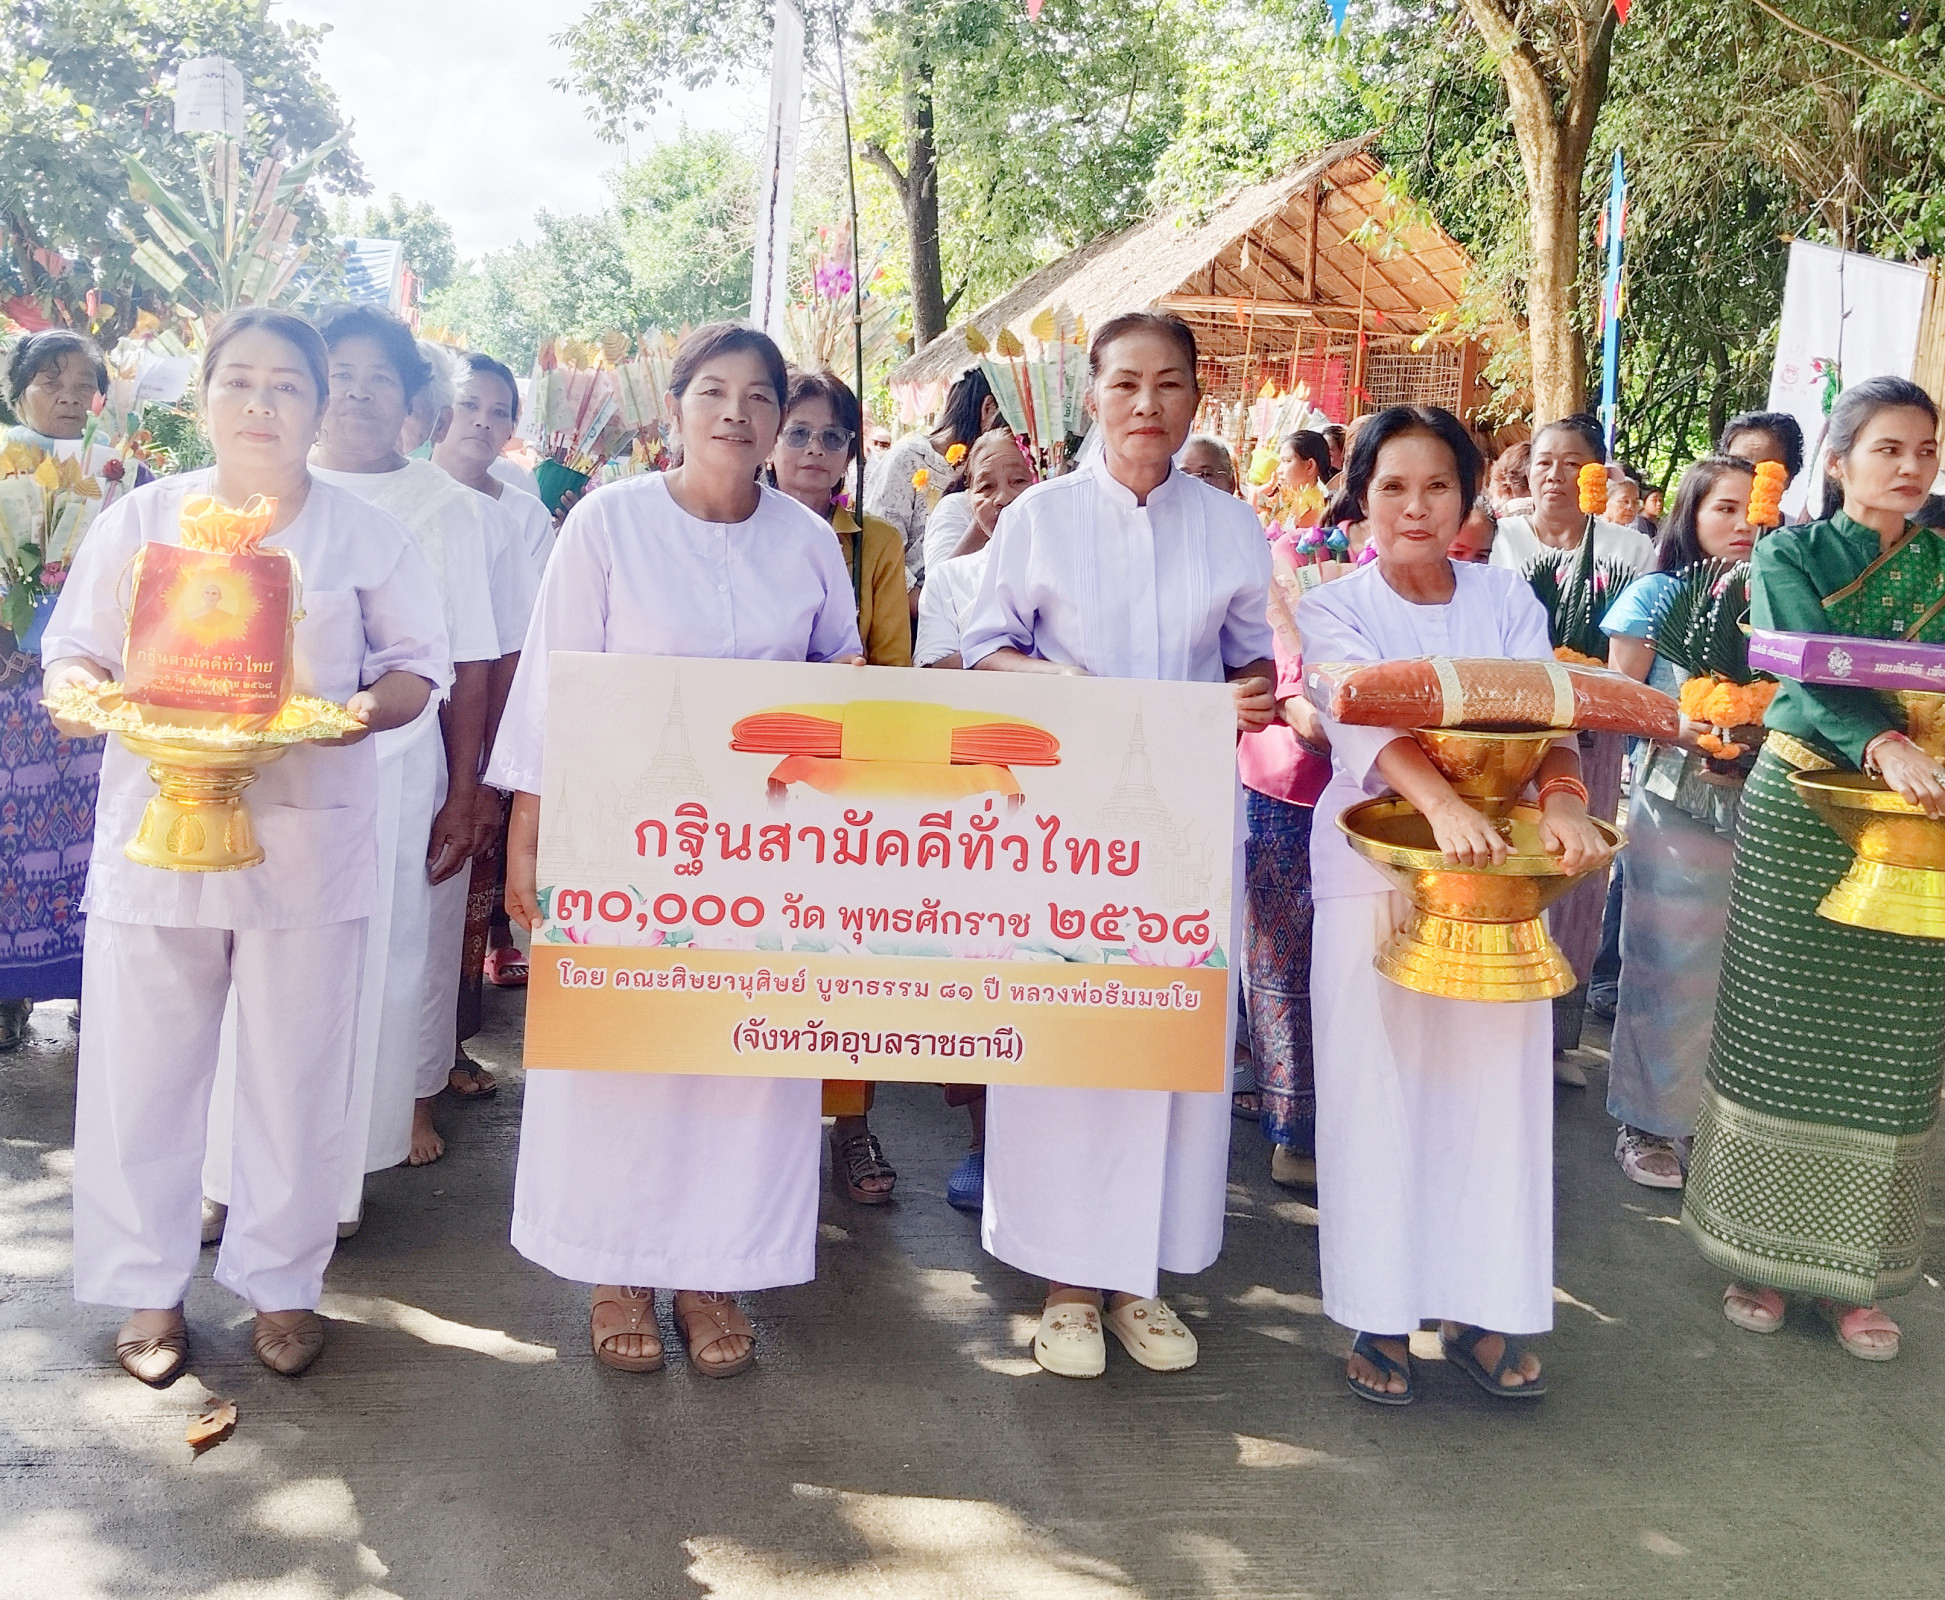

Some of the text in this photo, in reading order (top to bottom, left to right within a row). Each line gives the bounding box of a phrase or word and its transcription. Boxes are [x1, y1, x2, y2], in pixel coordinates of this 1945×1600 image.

[137, 648, 274, 673] กฐินสามัคคีทั่วไทย
[243, 680, 273, 690] ๒๕๖๘
[635, 800, 1140, 877] กฐินสามัคคีทั่วไทย
[557, 887, 1210, 946] ๓๐,๐๐๐ วัด พุทธศักราช ๒๕๖๘
[559, 961, 1199, 1010] โดย คณะศิษยานุศิษย์ บูชาธรรม ๘๑ ปี หลวงพ่อธัมมชโย
[732, 1018, 1024, 1065] (จังหวัดอุบลราชธานี)
